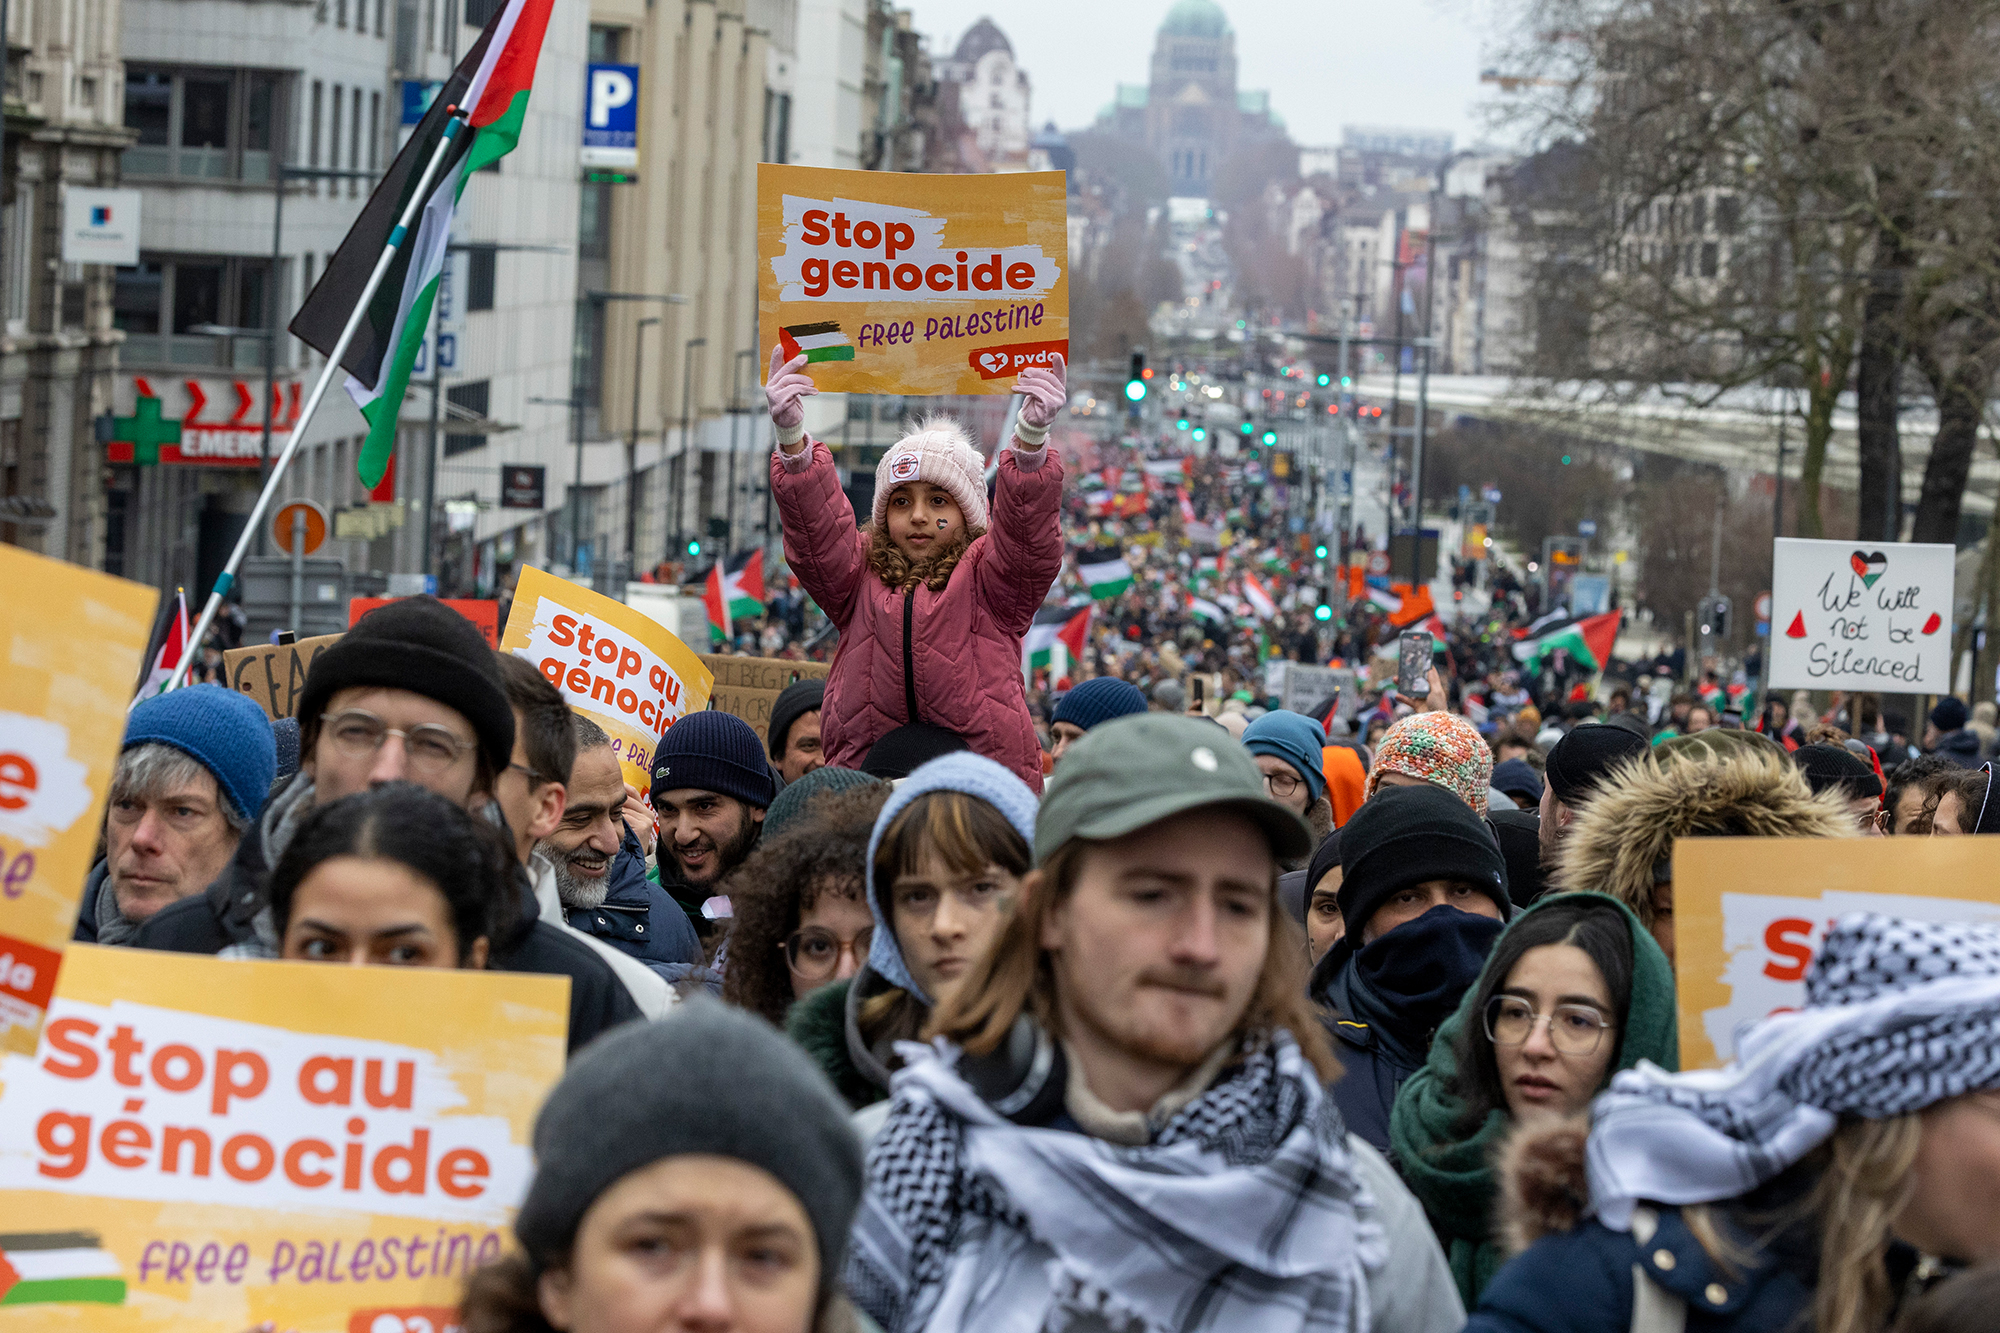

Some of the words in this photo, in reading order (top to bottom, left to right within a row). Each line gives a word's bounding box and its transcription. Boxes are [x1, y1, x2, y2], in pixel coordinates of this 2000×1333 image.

[591, 69, 633, 128] P
[800, 209, 915, 260] Stop
[801, 251, 1036, 297] genocide
[1817, 571, 1861, 612] We
[1829, 615, 1869, 640] not
[1888, 617, 1915, 644] be
[547, 614, 643, 680] Stop
[649, 664, 680, 707] au
[740, 663, 777, 690] BEG
[1807, 642, 1924, 683] Silenced
[42, 1016, 270, 1117] Stop
[297, 1053, 416, 1111] au
[35, 1098, 492, 1199] génocide
